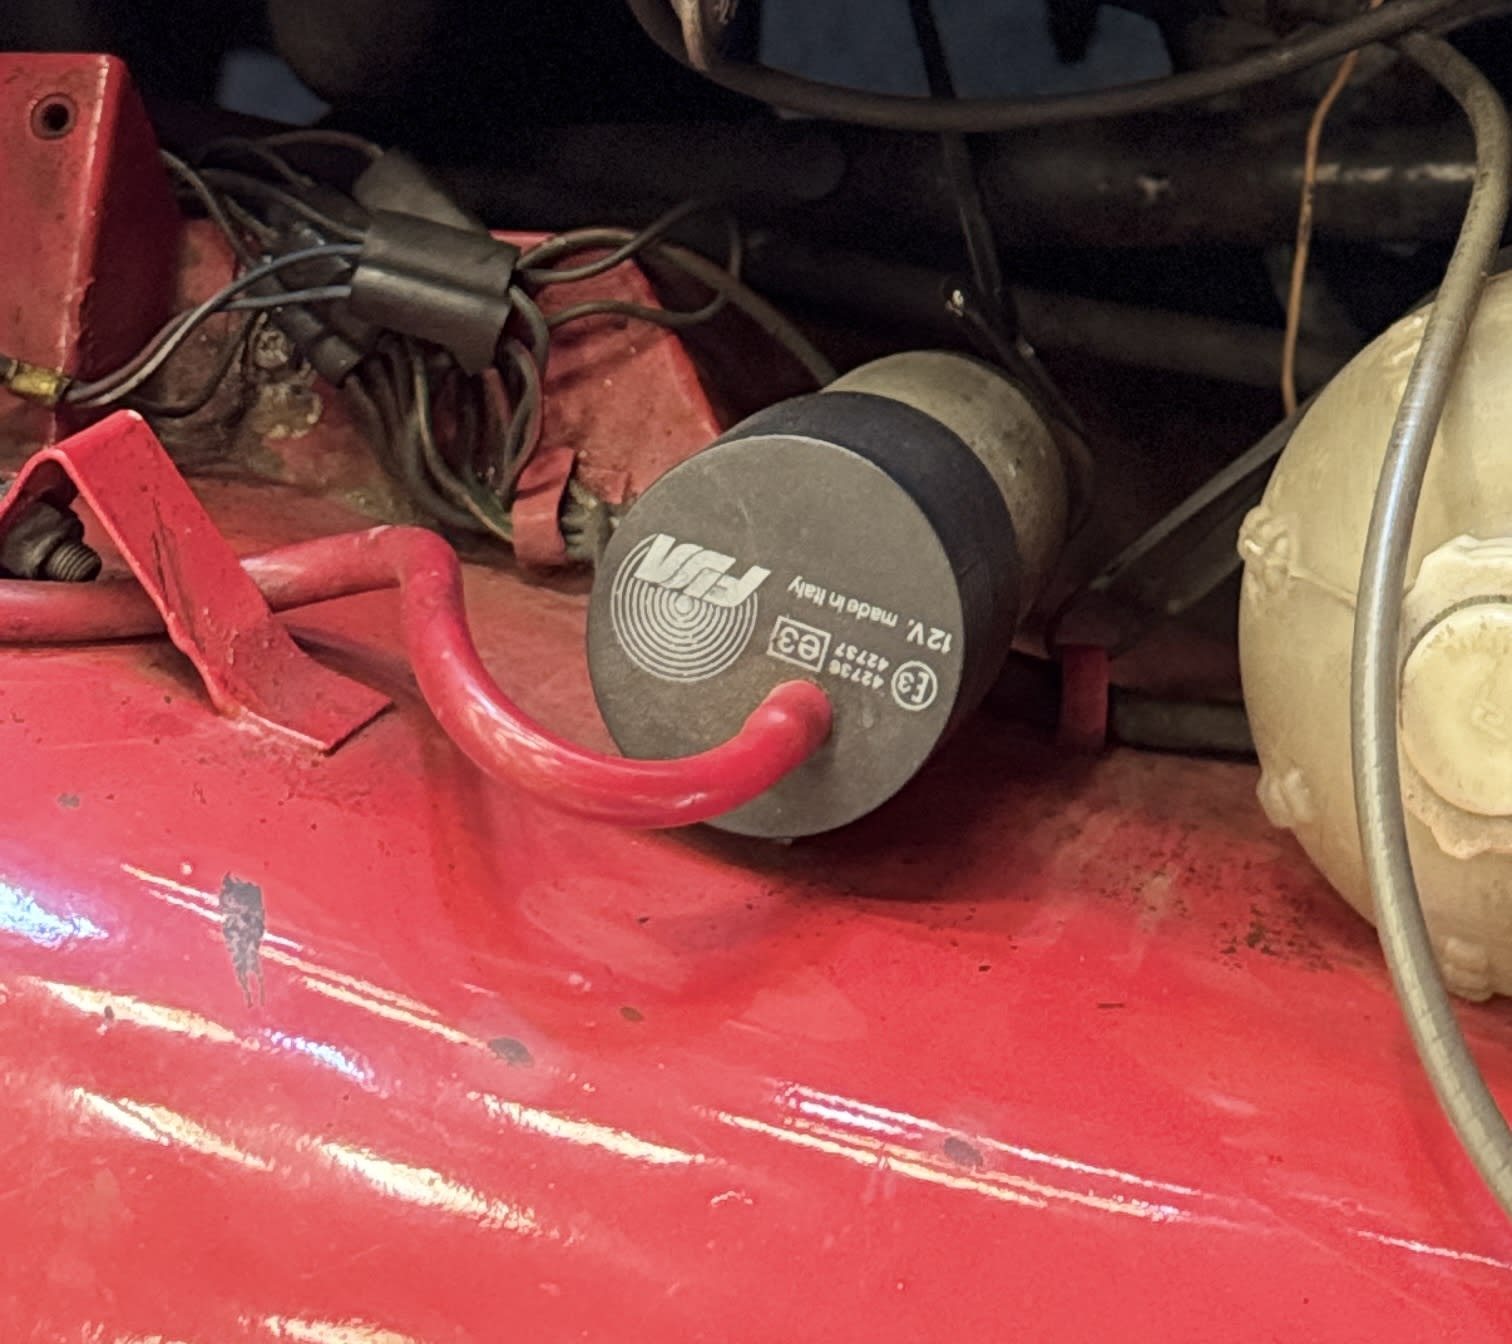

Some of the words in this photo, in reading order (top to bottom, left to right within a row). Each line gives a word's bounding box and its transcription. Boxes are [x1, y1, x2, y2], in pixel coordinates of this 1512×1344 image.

[788, 575, 829, 607] Italy
[828, 591, 846, 612] in
[846, 597, 900, 628] made
[776, 625, 821, 660] e3
[834, 641, 890, 671] 42737
[897, 669, 930, 703] E3
